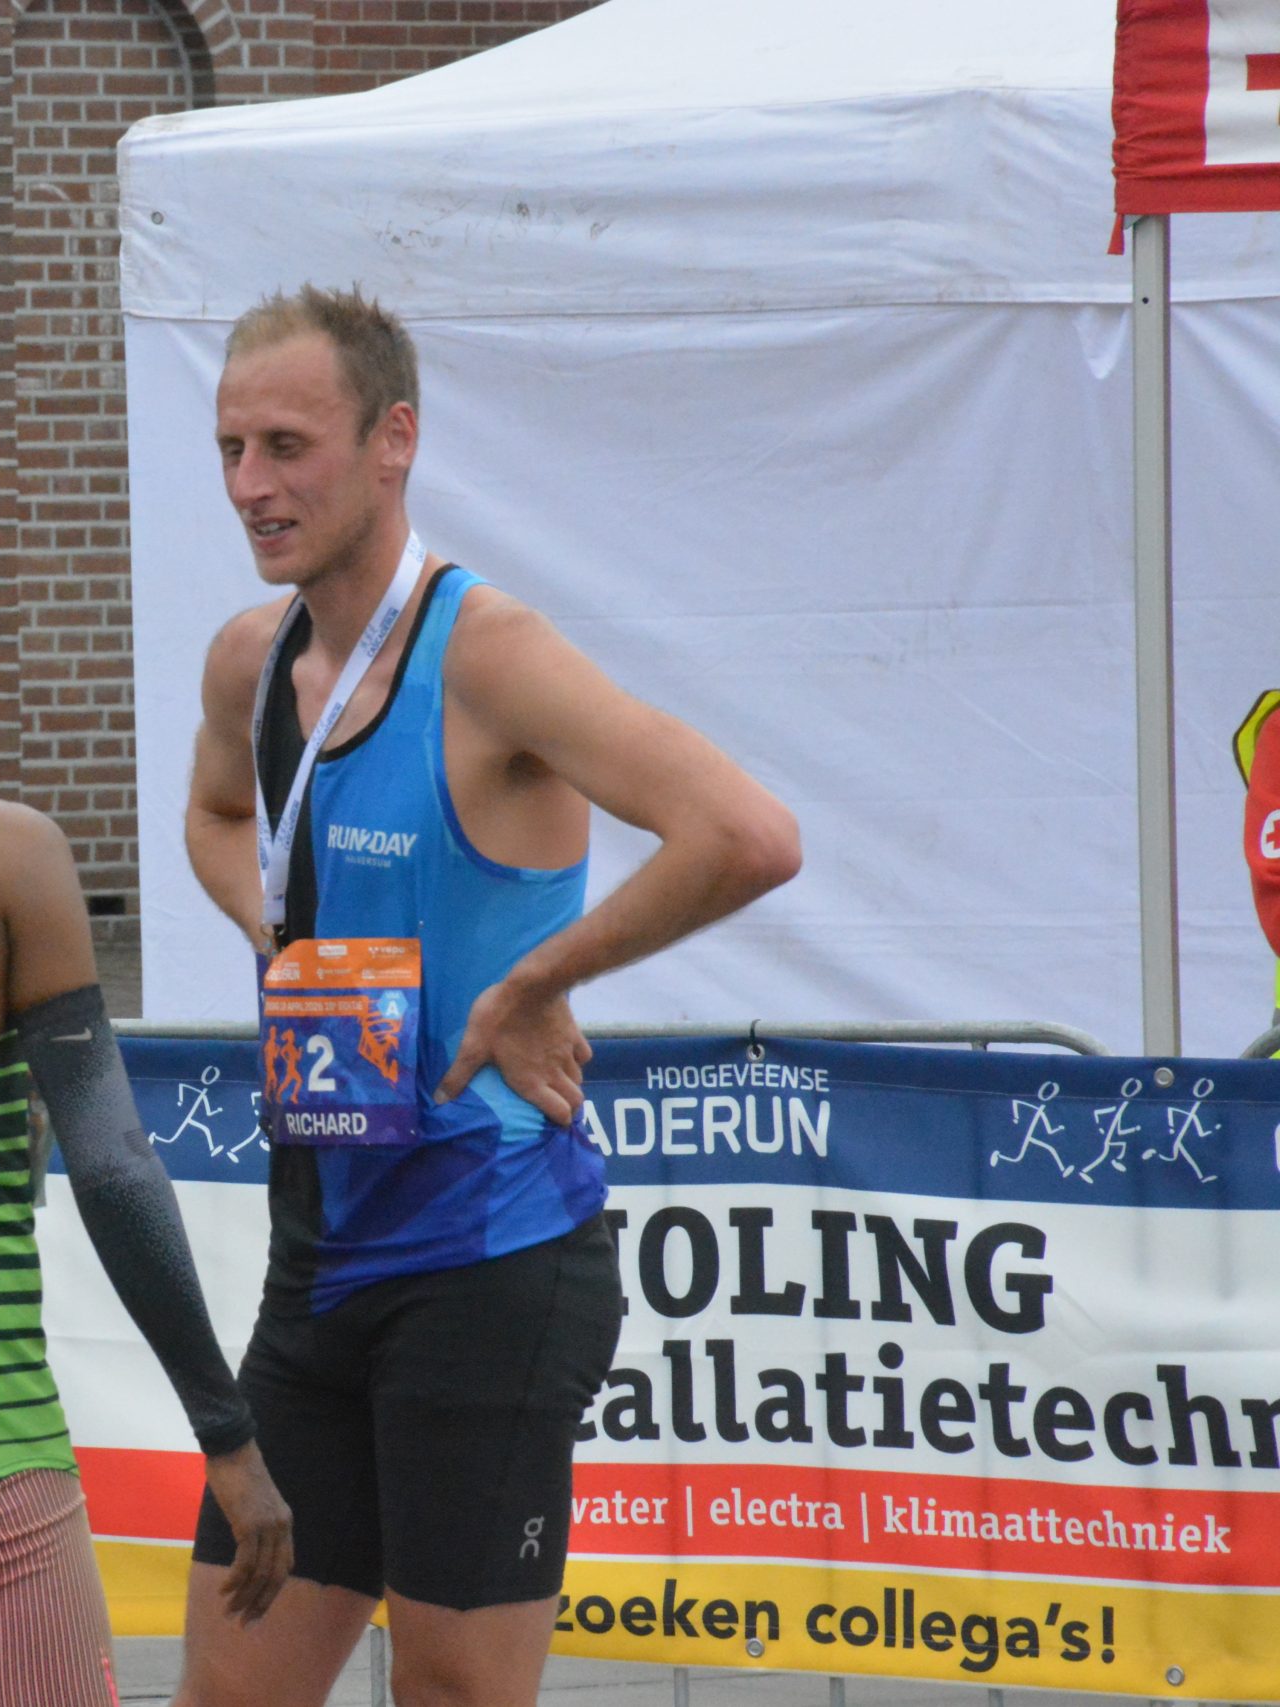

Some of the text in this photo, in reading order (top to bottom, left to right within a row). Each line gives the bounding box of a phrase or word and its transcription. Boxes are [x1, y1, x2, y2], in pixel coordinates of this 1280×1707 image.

[307, 1034, 336, 1092] 2
[646, 1063, 830, 1092] HOOGEVEENSE
[286, 1112, 368, 1135] RICHARD
[607, 1206, 1054, 1334] OLING
[709, 1487, 844, 1530] electra
[882, 1496, 1232, 1554] klimaattechniek
[806, 1587, 1116, 1673] collega's!
